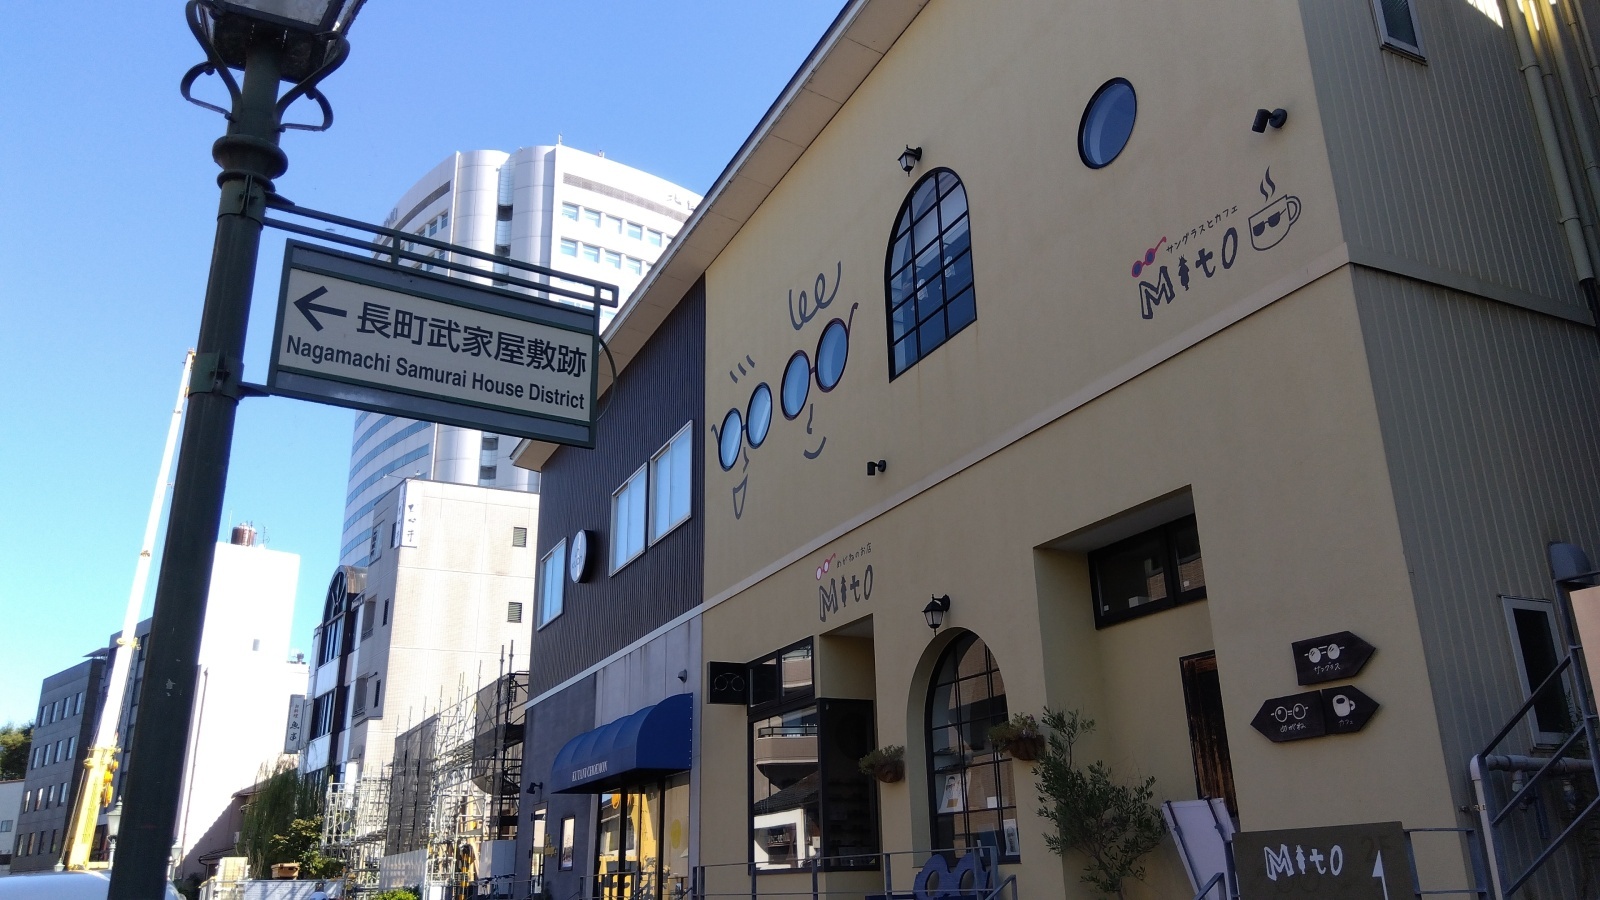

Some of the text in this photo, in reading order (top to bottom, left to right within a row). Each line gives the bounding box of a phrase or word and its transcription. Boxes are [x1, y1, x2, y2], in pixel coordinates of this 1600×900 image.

[1166, 205, 1238, 254] サングラスとカフェ
[356, 301, 588, 378] 長町武家屋敷跡
[286, 334, 585, 410] Nagamachi Samurai House District
[1313, 661, 1341, 675] サングラス
[1280, 722, 1307, 733] めがね
[1338, 719, 1354, 727] カフェ
